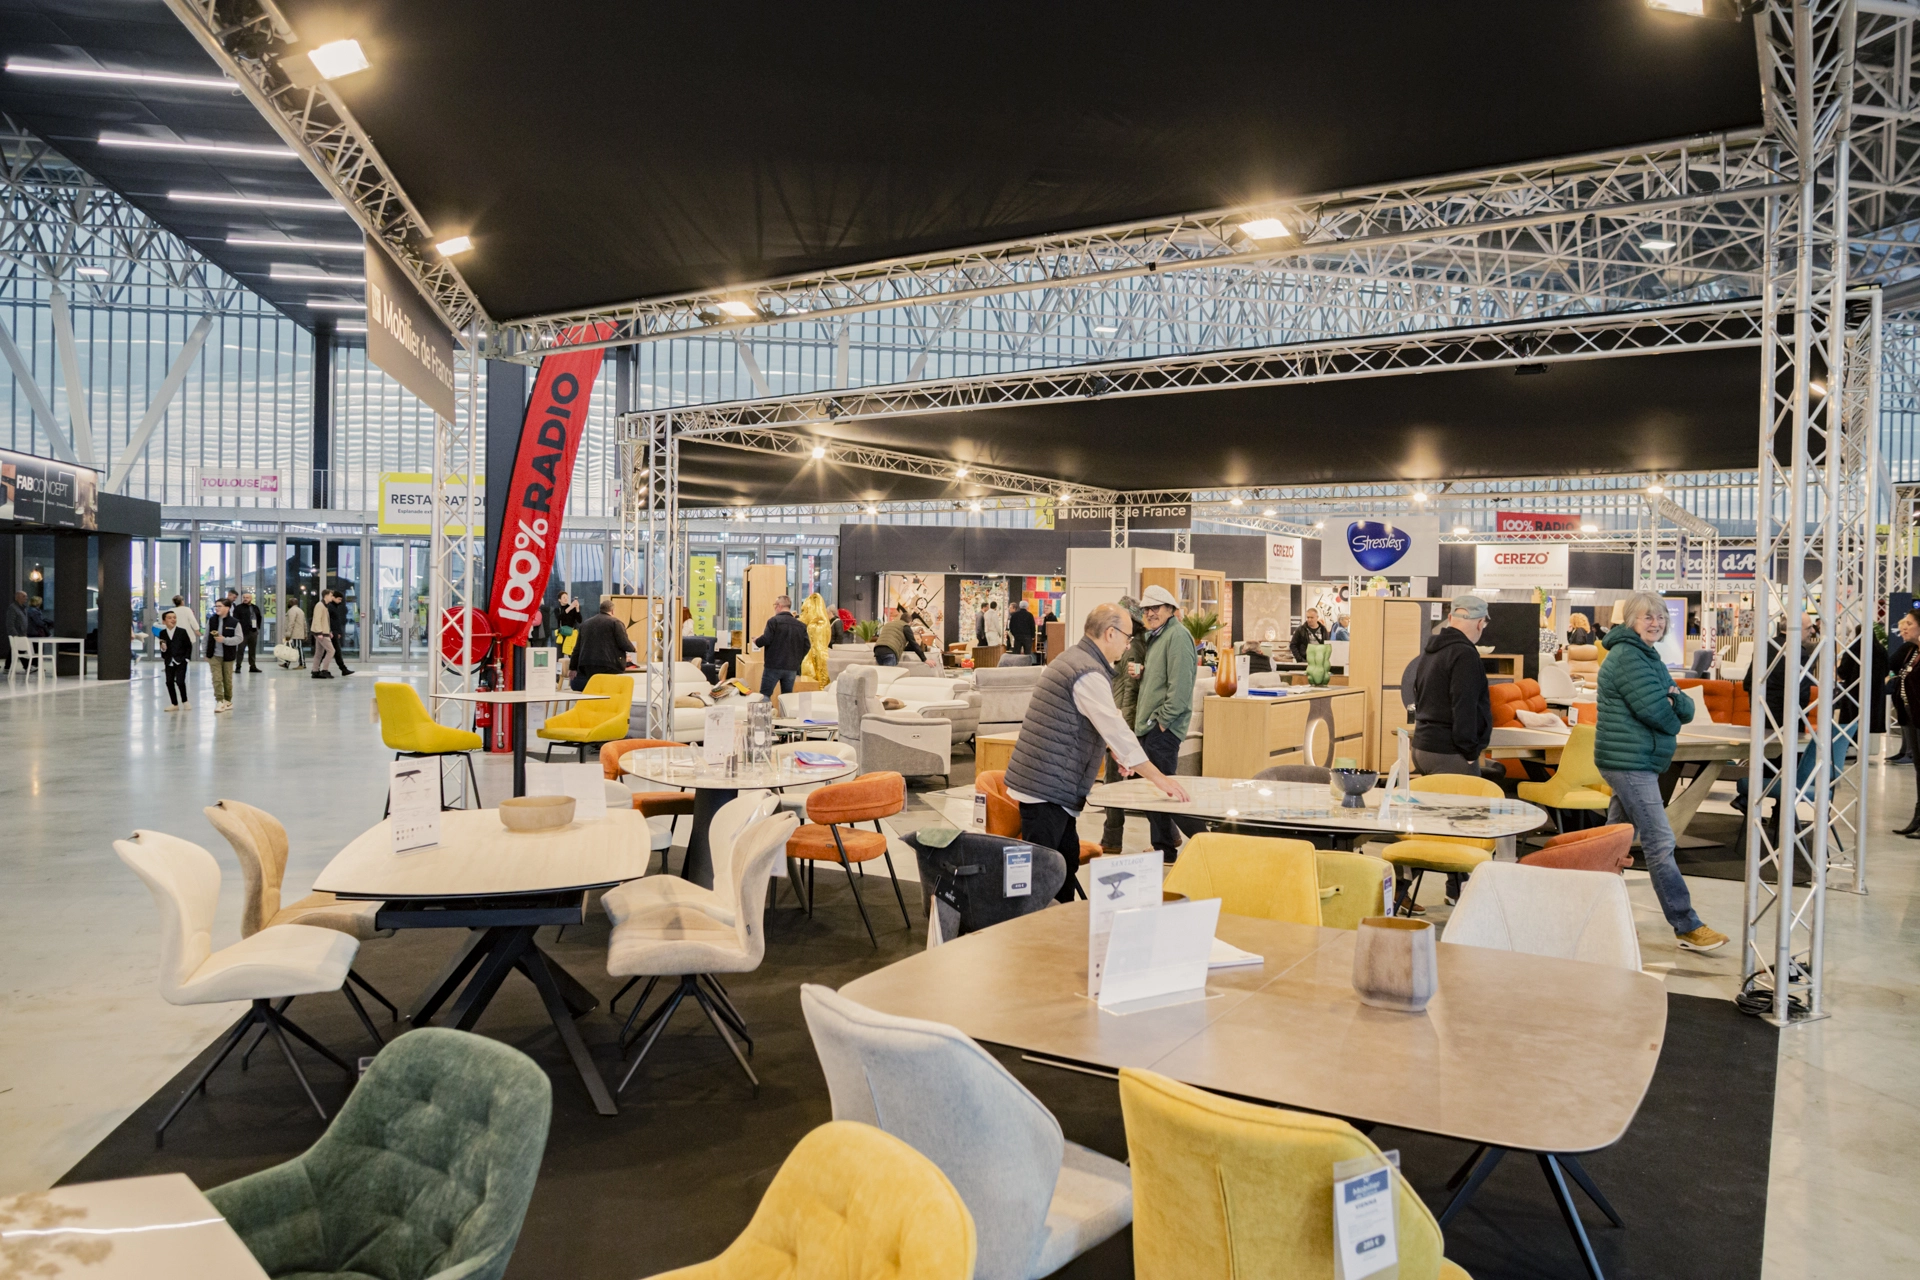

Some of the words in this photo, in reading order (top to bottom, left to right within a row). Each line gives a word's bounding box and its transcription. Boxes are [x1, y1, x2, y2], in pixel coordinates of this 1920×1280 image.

[383, 294, 420, 359] Mobilier
[420, 334, 431, 371] de
[431, 345, 454, 391] France
[522, 372, 580, 513] RADIO
[201, 476, 260, 489] TOULOUSE
[260, 475, 279, 491] FM
[391, 494, 485, 506] RESTARATO
[1071, 506, 1115, 519] Mobilie
[1142, 505, 1187, 517] France
[1502, 519, 1535, 532] 100%
[1535, 520, 1575, 532] RADIO
[1272, 543, 1294, 558] CEREZO
[1352, 533, 1405, 553] Stressless
[1494, 552, 1549, 565] CEREZO
[1722, 554, 1756, 571] d'A
[498, 518, 549, 622] 100%
[698, 561, 706, 636] RESTARANT
[1111, 858, 1144, 867] SANTIAGO
